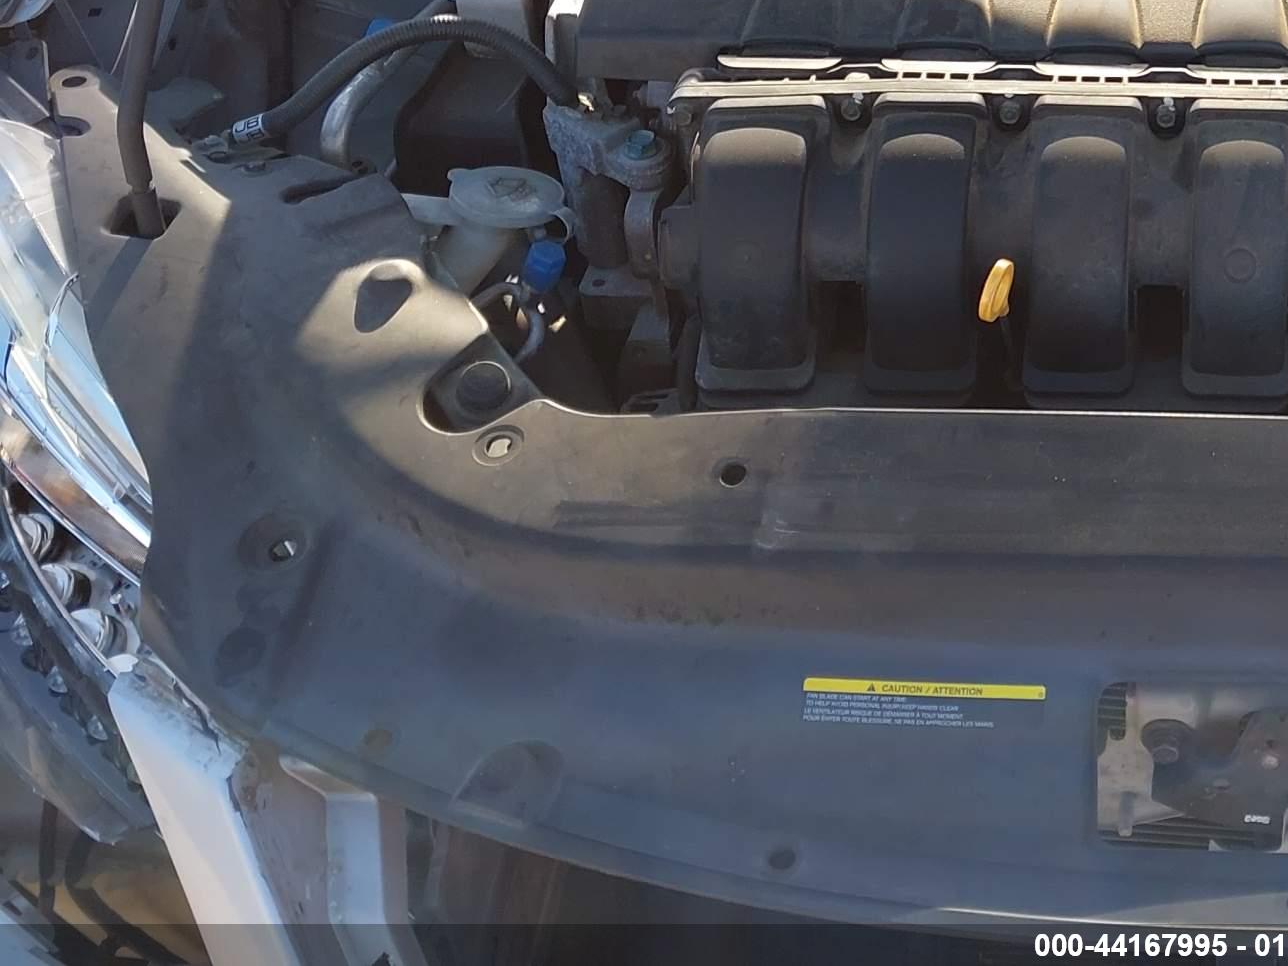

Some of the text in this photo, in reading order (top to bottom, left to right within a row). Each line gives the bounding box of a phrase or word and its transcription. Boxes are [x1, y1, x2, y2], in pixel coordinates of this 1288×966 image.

[881, 684, 984, 696] CAUTION / ATTENTION
